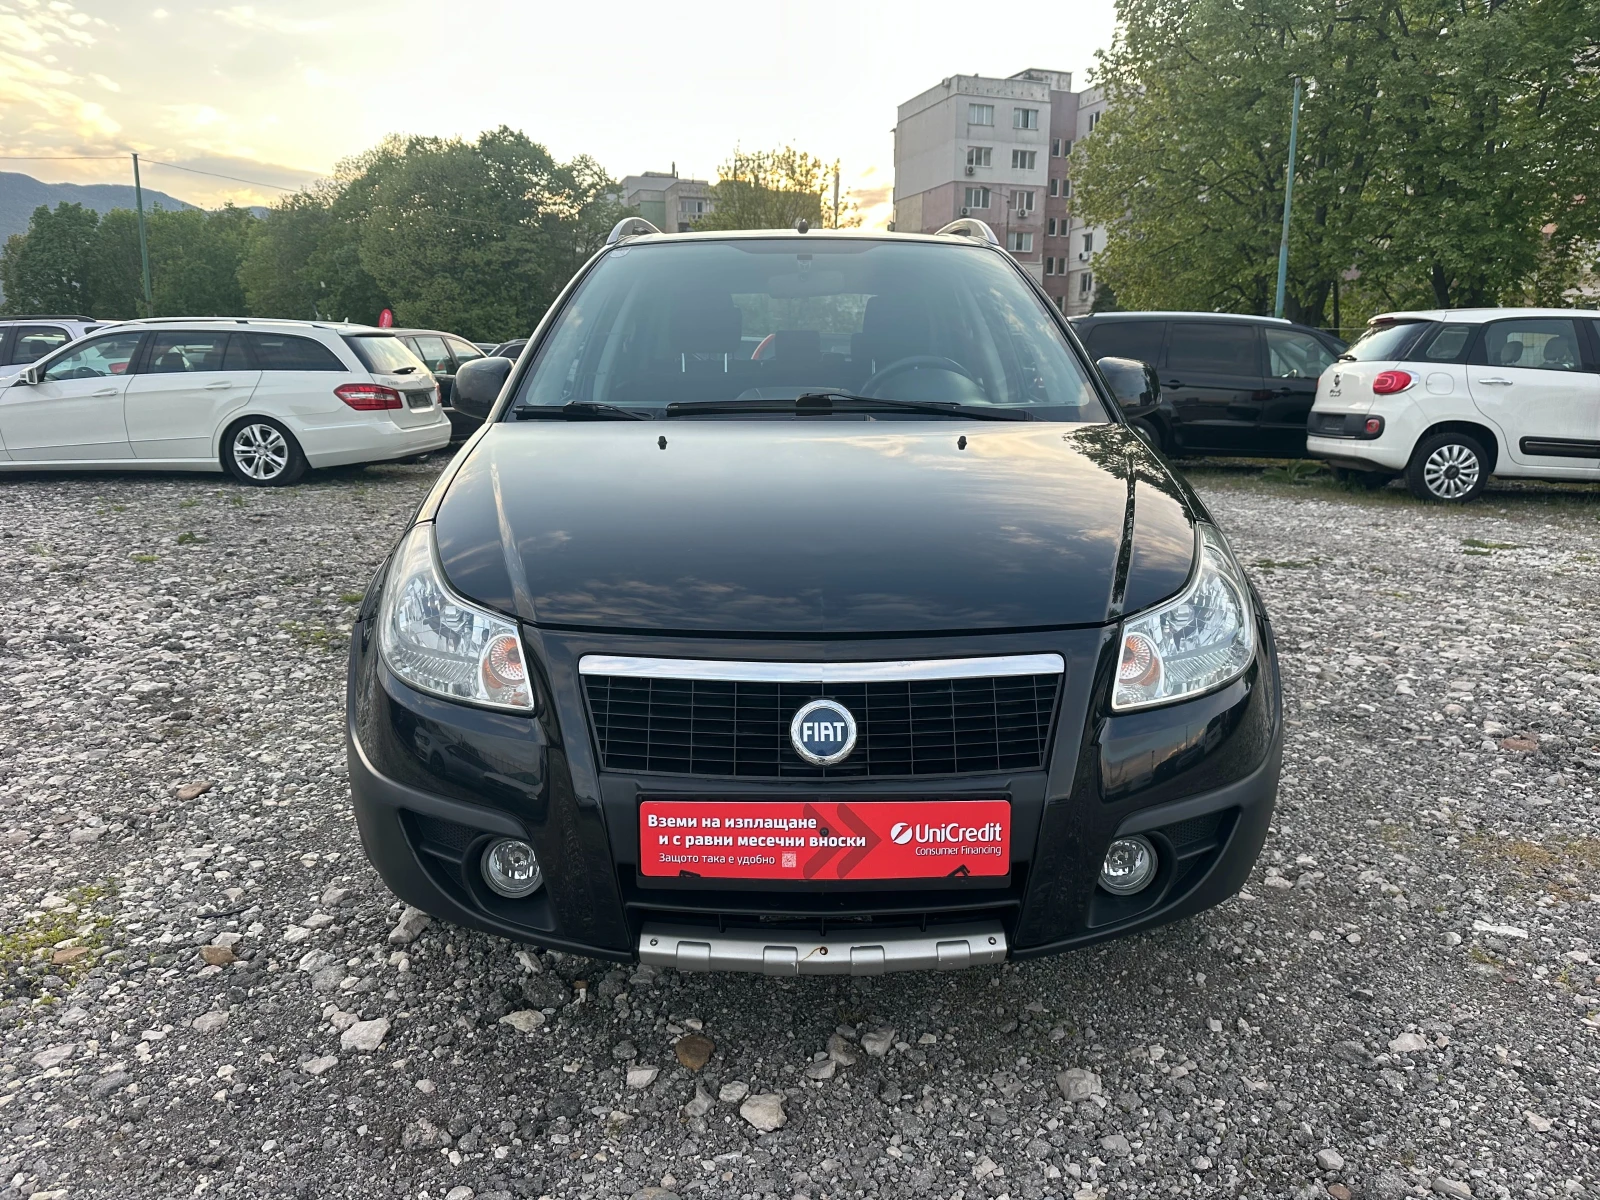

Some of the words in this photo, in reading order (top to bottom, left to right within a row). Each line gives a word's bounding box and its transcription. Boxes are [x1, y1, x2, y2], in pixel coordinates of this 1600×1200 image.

[802, 722, 845, 742] FIAT
[647, 814, 697, 827] Вземи
[701, 817, 720, 828] на
[725, 817, 817, 831] изплащане
[915, 822, 1002, 843] UniCredit
[658, 835, 669, 845] и
[672, 835, 681, 845] с
[685, 835, 733, 849] равни
[737, 836, 805, 847] месечни
[809, 836, 866, 847] вноски
[915, 846, 959, 856] Consumer
[961, 844, 1002, 857] Financing
[658, 852, 699, 864] Защото
[701, 855, 726, 863] така
[728, 855, 735, 863] е
[737, 854, 776, 866] удобно
